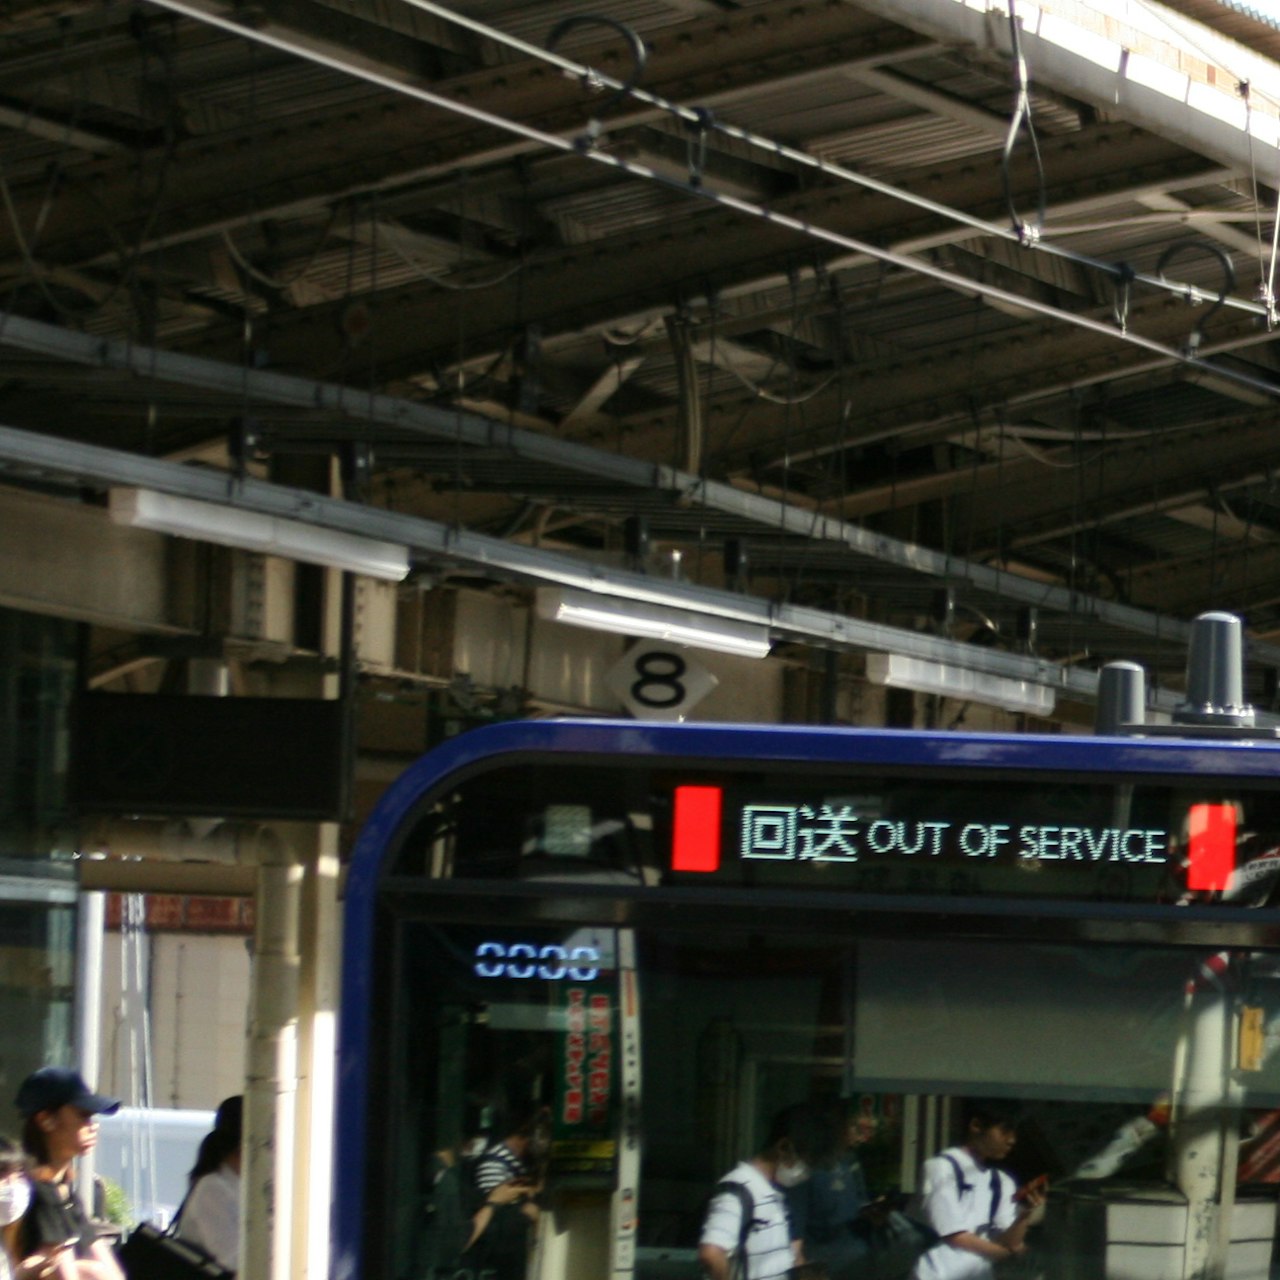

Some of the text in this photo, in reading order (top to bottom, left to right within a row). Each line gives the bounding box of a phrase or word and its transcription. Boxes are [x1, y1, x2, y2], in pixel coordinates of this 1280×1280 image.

[631, 652, 686, 709] 8
[741, 804, 858, 862] 回送
[866, 820, 1168, 864] OUT OF SERVICE
